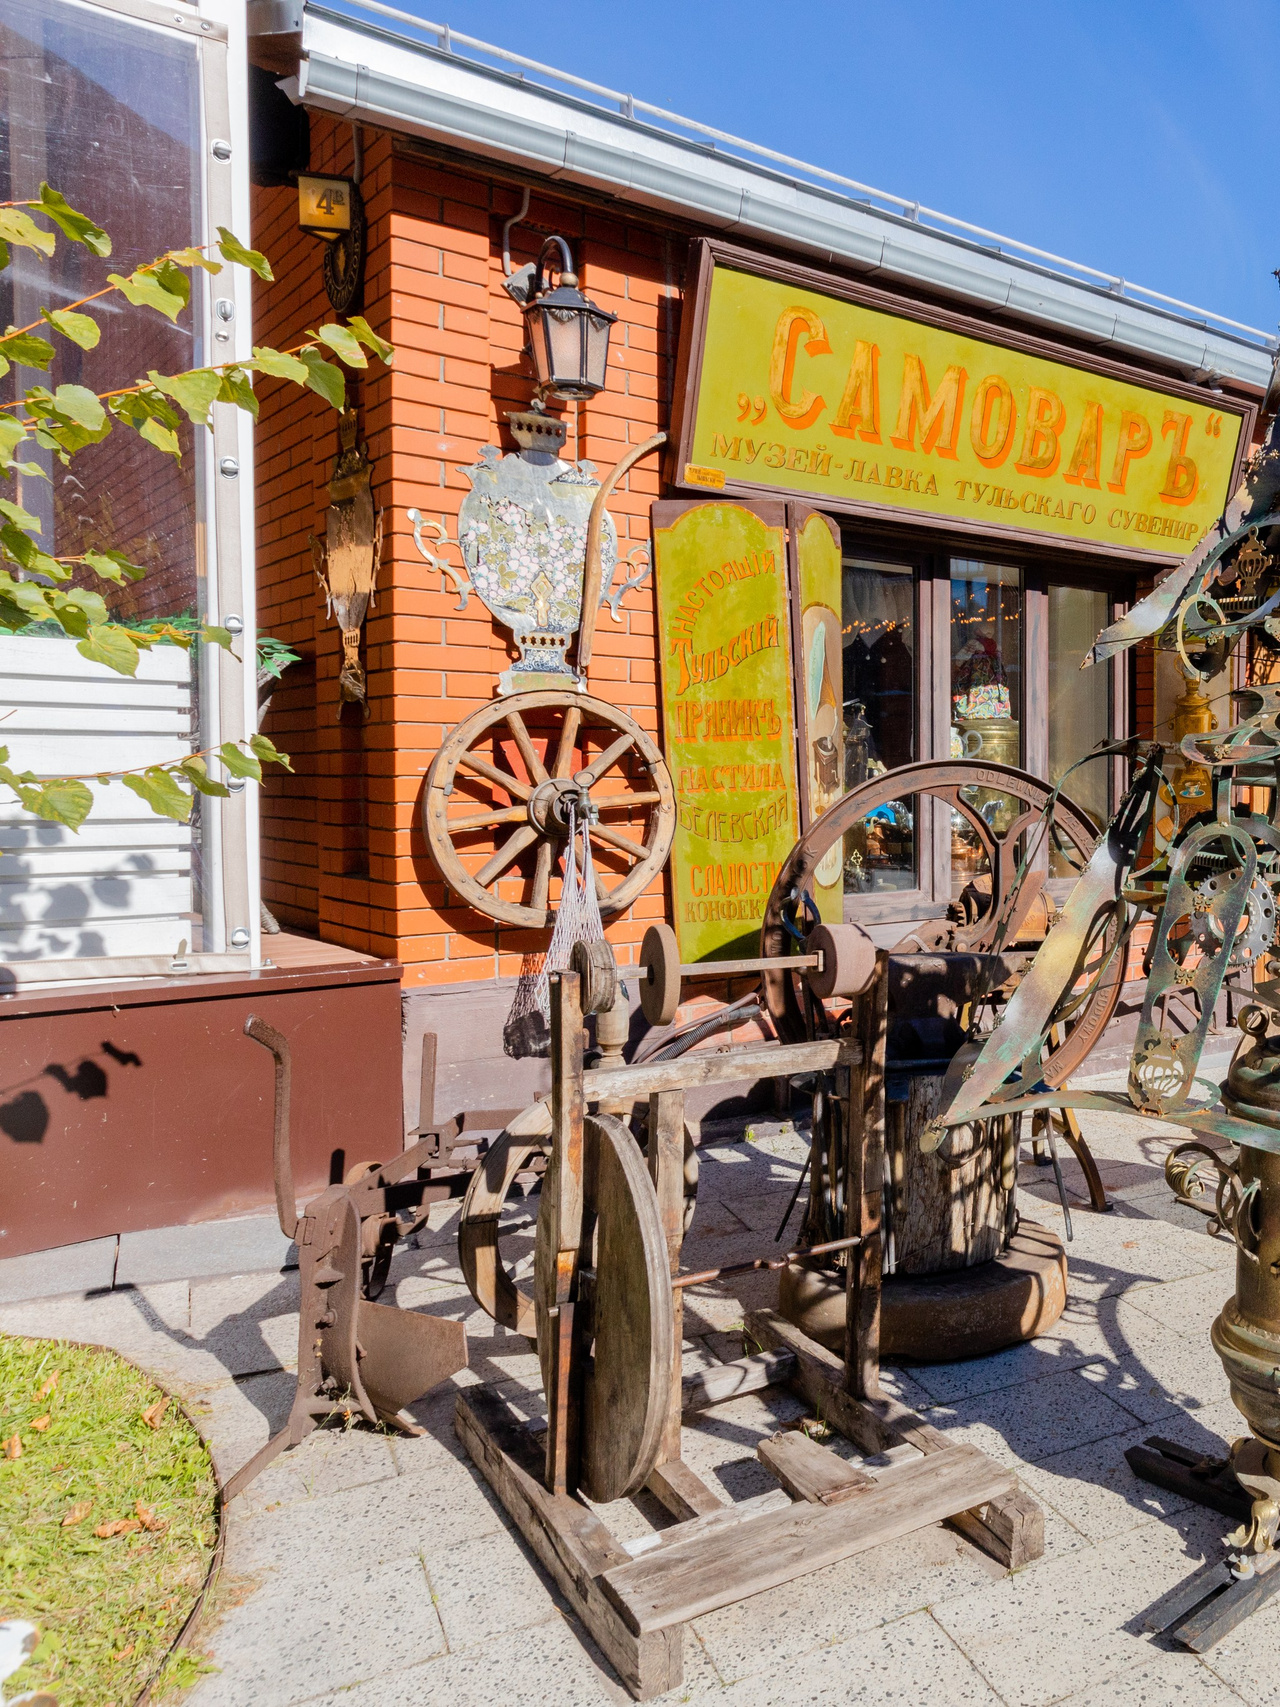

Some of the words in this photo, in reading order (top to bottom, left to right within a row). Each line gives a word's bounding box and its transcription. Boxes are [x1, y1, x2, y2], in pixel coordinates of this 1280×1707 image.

[709, 431, 939, 496] МУЗЕЙ-ЛАВКА
[953, 479, 1097, 525] ТУЛЬСКАГО
[674, 698, 782, 744] ПРЯНИКЪ
[677, 763, 788, 794] ПАСТИЛА
[679, 791, 789, 843] БЕЛЕВСКАЯ
[1060, 810, 1098, 858] ZELAZ
[683, 898, 766, 923] КОНФЕК
